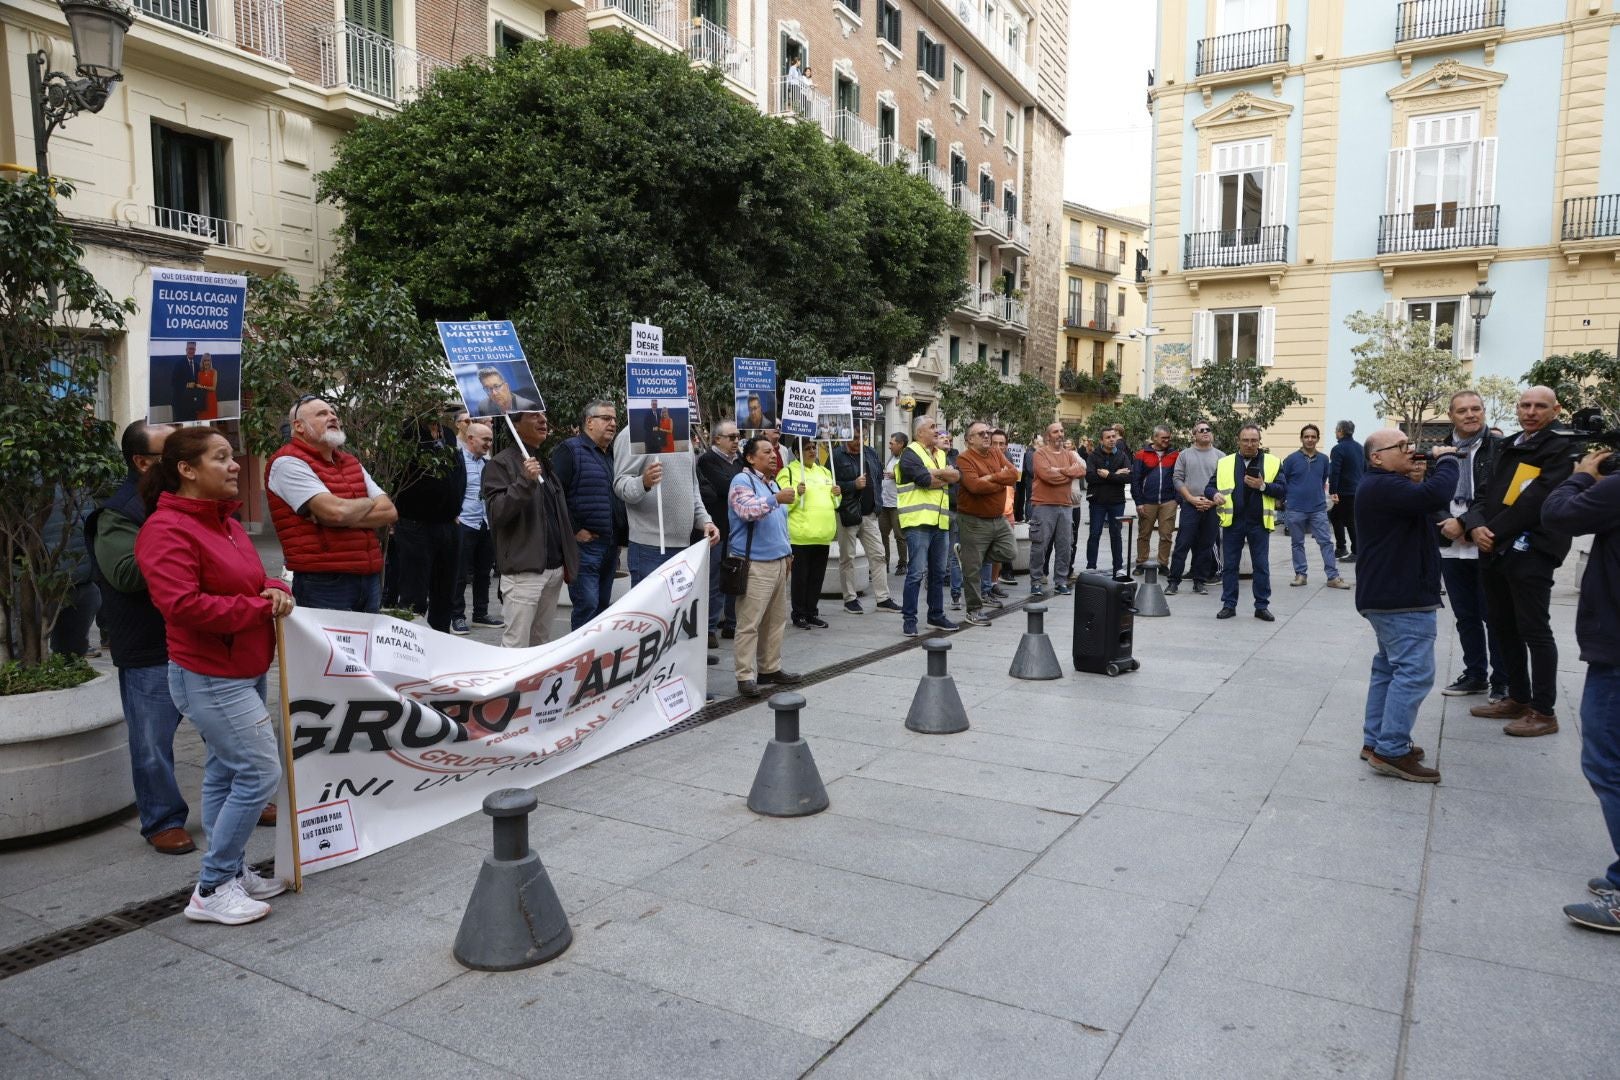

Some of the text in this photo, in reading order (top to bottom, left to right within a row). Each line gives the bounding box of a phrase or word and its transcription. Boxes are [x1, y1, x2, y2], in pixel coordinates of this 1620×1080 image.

[176, 274, 203, 282] DESASTRE
[214, 277, 237, 285] GESTIÓN
[159, 289, 237, 304] ELLOS LA CAGAN
[167, 304, 228, 316] Y NOSOTROS
[166, 318, 228, 330] LO PAGAMOS
[452, 345, 515, 353] RESPONSABLE
[637, 341, 659, 351] DESRE
[790, 394, 815, 403] PRECA
[789, 401, 814, 410] RIEDAD
[788, 409, 813, 418] LABORAL
[612, 620, 652, 634] TAXI
[376, 635, 401, 647] MATA
[403, 640, 413, 650] AL
[289, 691, 522, 760] GRUPO
[568, 598, 698, 708] ALBÁN
[419, 750, 515, 766] GRUPO
[520, 714, 607, 760] ALBÁN
[318, 777, 394, 803] ¡NI
[301, 812, 342, 828] ¡DIGNIDAD PARA
[315, 824, 343, 836] TAXISTAS!
